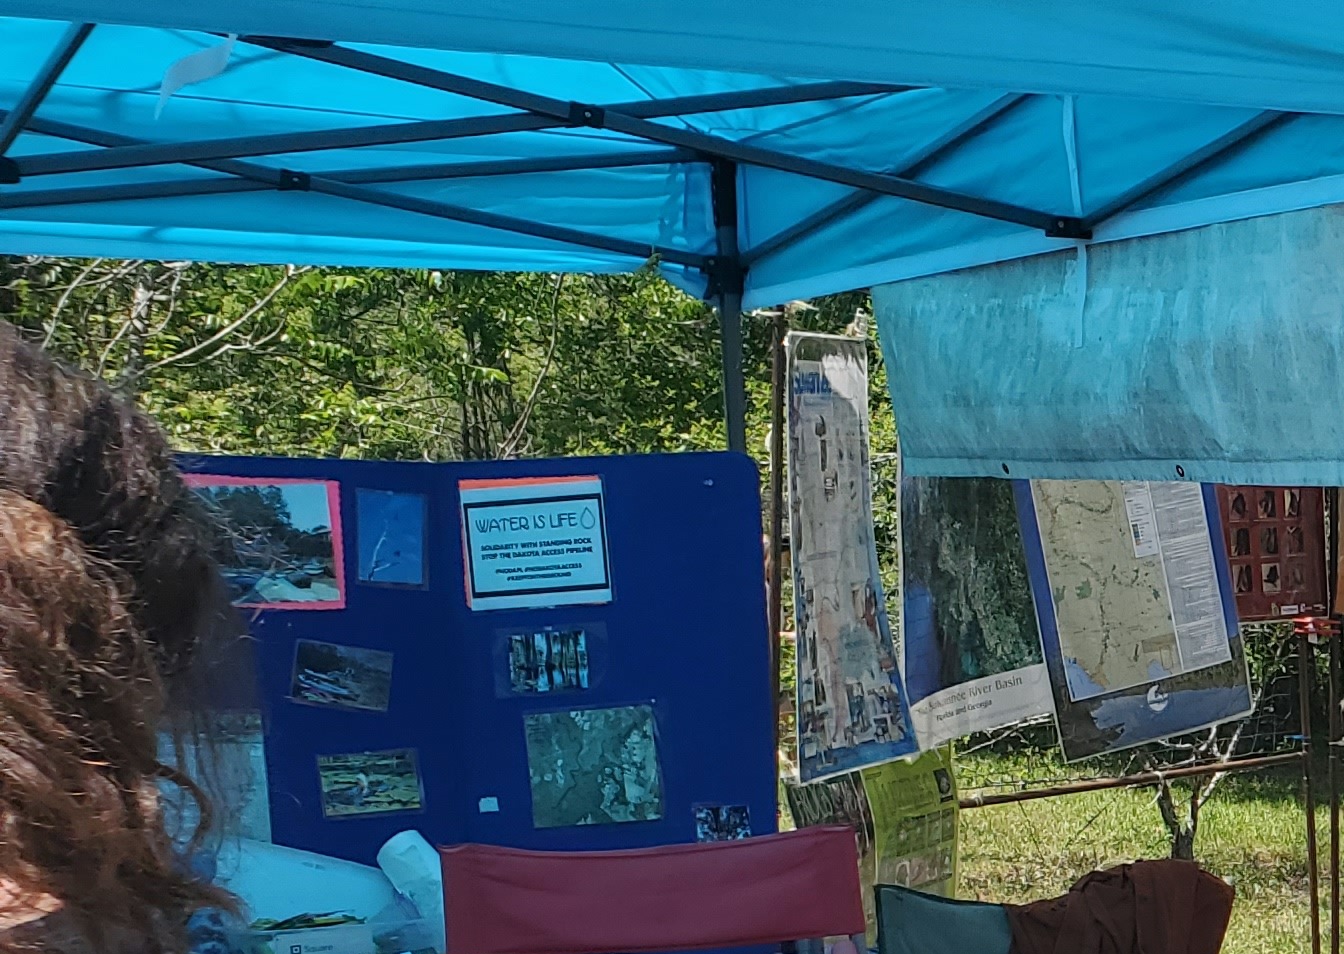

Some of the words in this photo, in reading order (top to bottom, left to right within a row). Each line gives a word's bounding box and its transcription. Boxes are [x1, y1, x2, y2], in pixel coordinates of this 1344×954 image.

[475, 516, 530, 534] WATER
[533, 514, 546, 529] IS
[549, 512, 579, 529] LIFE
[520, 541, 538, 550] WITH
[538, 538, 573, 549] STANDING
[573, 537, 592, 545] ROCK
[481, 552, 498, 561] STOP
[499, 551, 511, 560] THE
[512, 550, 540, 558] DAKOTA
[541, 548, 565, 557] ACCESS
[968, 683, 993, 699] River
[994, 675, 1023, 691] Basin
